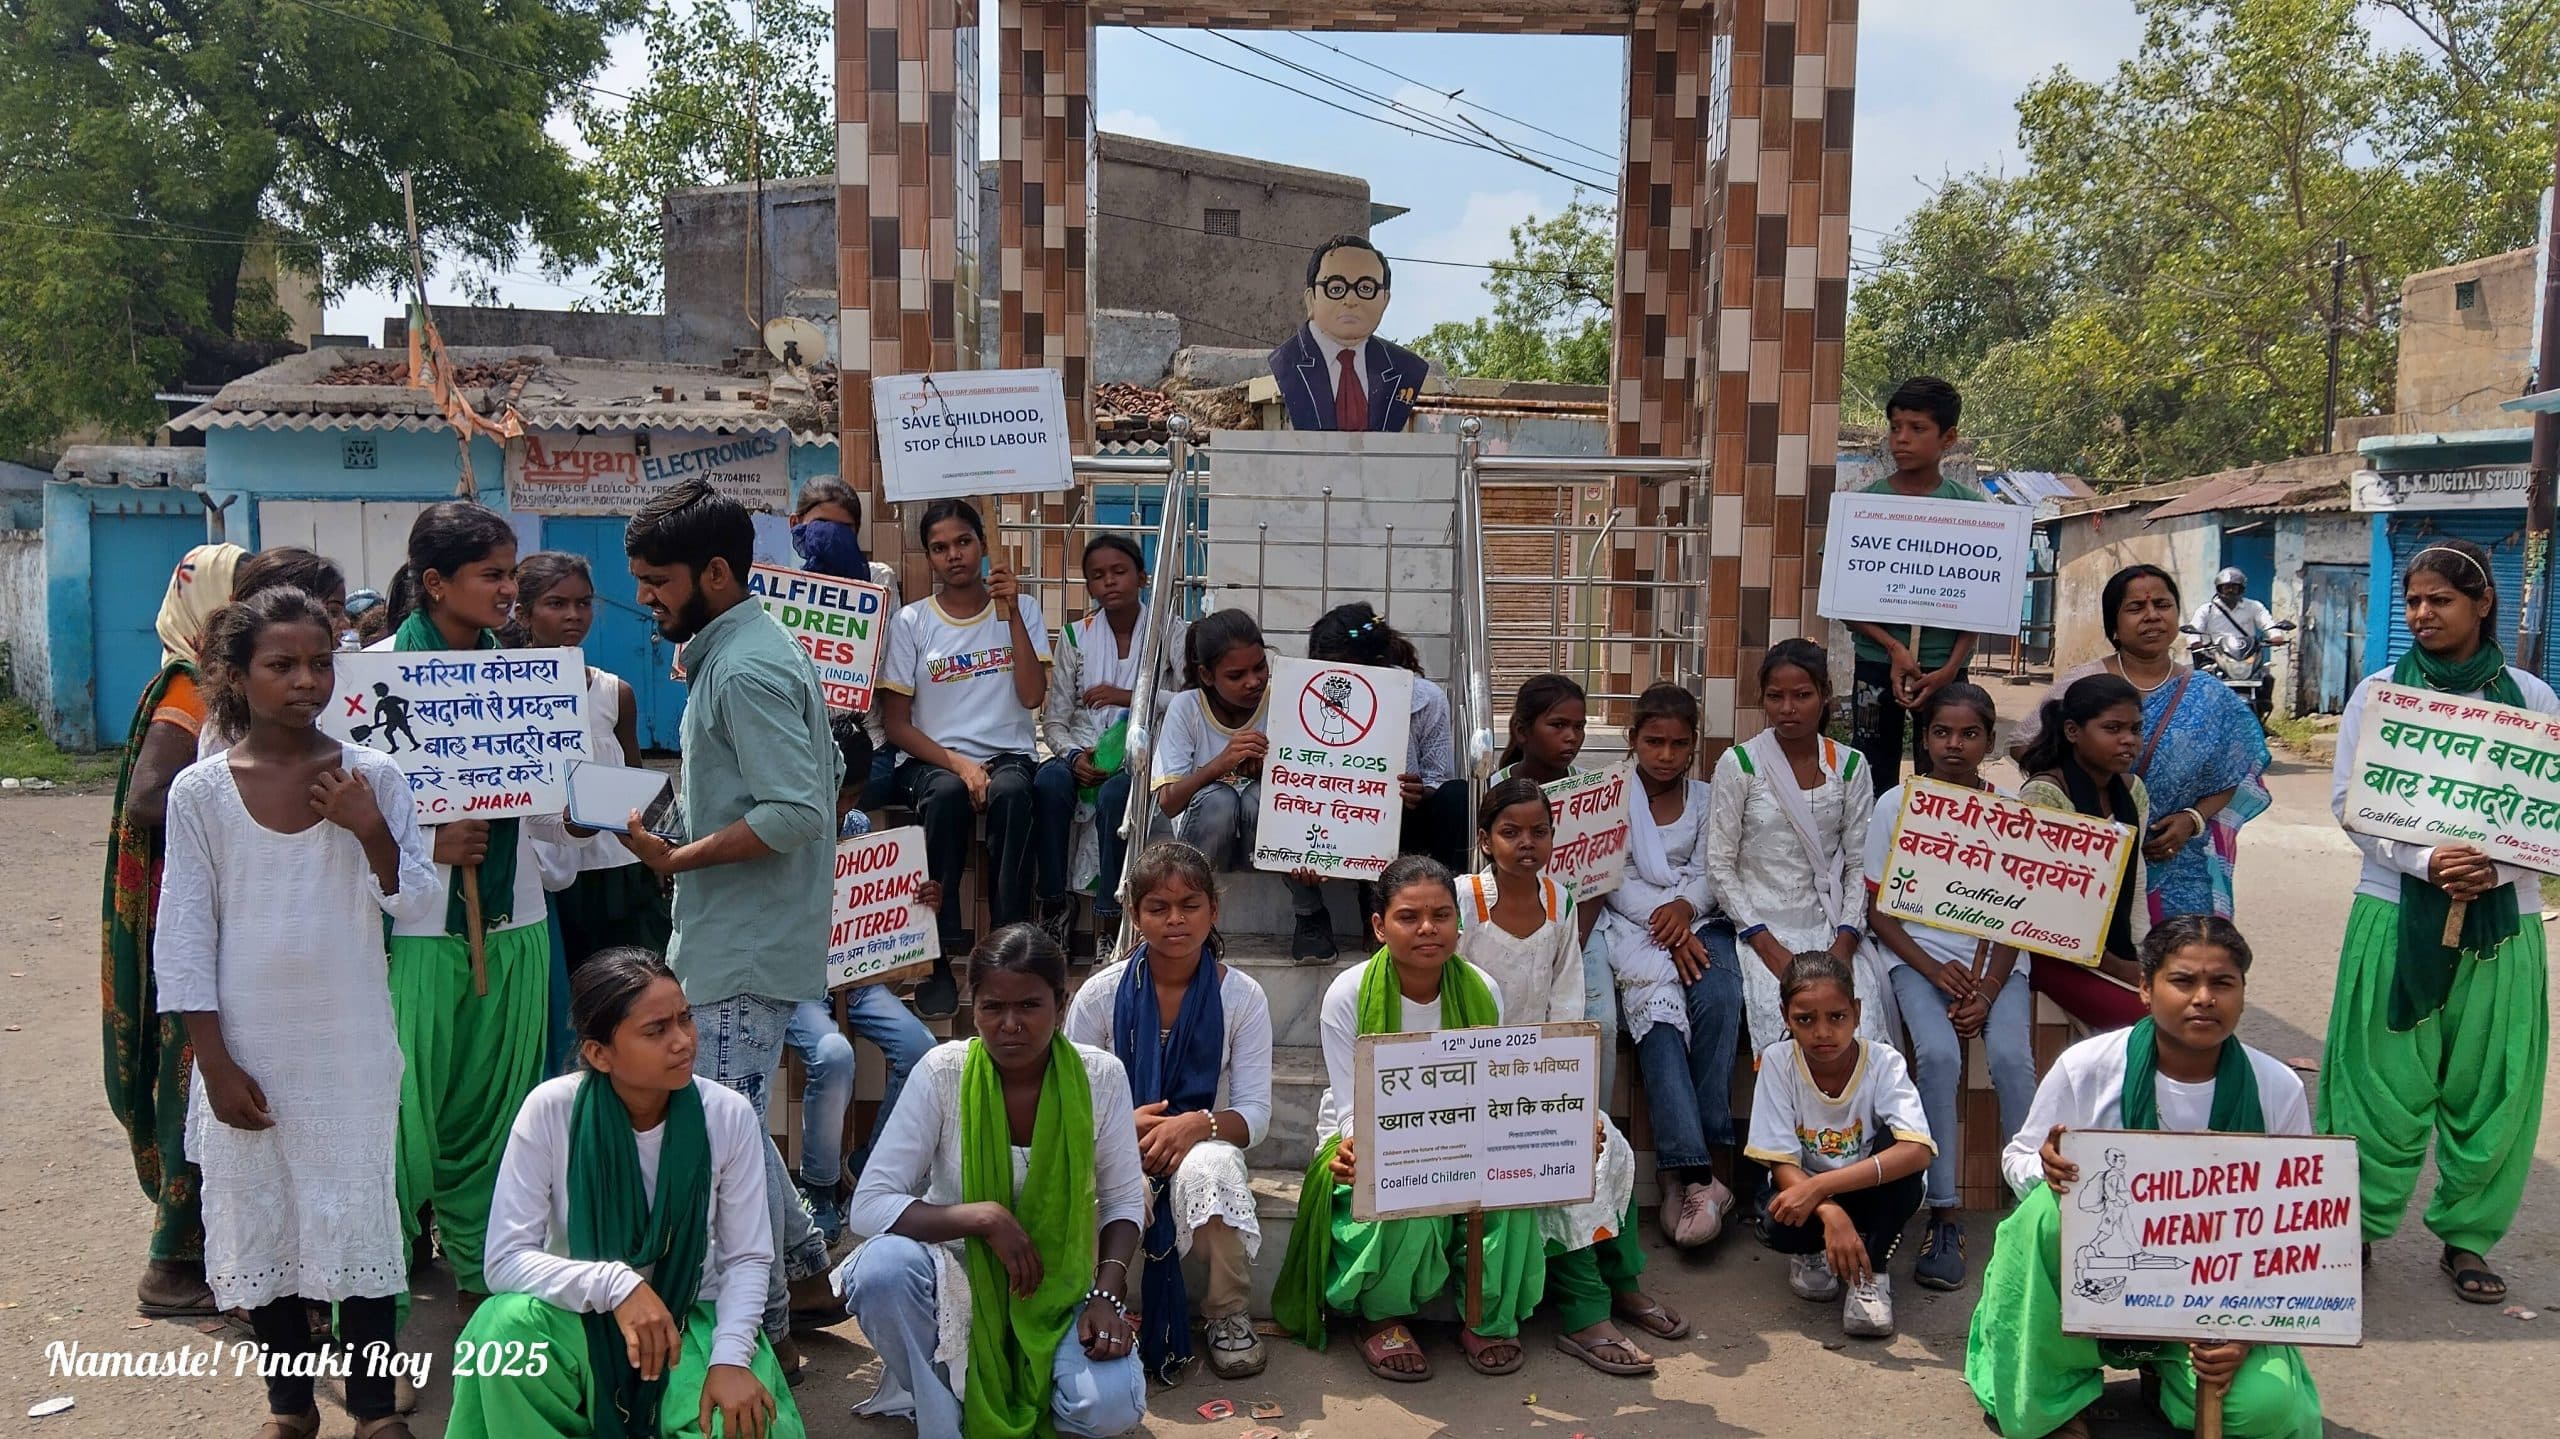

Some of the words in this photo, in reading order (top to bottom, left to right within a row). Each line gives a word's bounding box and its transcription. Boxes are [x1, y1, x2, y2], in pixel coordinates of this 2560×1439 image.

[902, 414, 941, 430] SAVE
[945, 409, 1044, 426] CHILDHOOD,
[905, 440, 940, 452] STOP
[945, 435, 985, 449] CHILD
[990, 432, 1047, 446] LABOUR
[520, 436, 639, 483] Aryan
[642, 436, 778, 481] ELECTRONICS
[515, 483, 534, 492] ALL
[539, 483, 571, 493] TYPES
[573, 484, 587, 492] OF
[591, 483, 631, 493] LED/LCD
[2429, 472, 2483, 491] DIGITAL
[2486, 470, 2532, 490] STUDI
[1851, 535, 1892, 550] SAVE
[1897, 538, 2002, 562] CHILDHOOD,
[1848, 559, 1885, 572] STOP
[1890, 561, 1934, 576] CHILD
[1939, 565, 2000, 583] LABOUR
[749, 573, 878, 614] ALFIELD
[1886, 583, 1906, 593] 12th
[1909, 585, 1936, 596] June
[1940, 587, 1966, 598] 2025
[764, 602, 868, 640] DREN
[797, 636, 854, 665] SES
[481, 655, 559, 684] कोयला
[825, 666, 869, 686] (INDIA)
[414, 692, 484, 727] खदानों
[486, 690, 504, 725] से
[2378, 690, 2391, 704] 12
[2429, 701, 2459, 720] बाल
[2461, 707, 2488, 721] श्रम
[2493, 710, 2541, 731] निषेध
[2545, 717, 2560, 741] दि
[547, 730, 586, 754] बन्द
[2380, 718, 2485, 765] बचपन
[1279, 747, 1292, 760] 12
[1342, 754, 1387, 772] 2025
[1318, 775, 1354, 794] बाल
[1357, 780, 1387, 797] श्रम
[1569, 774, 1624, 820] बचाओ
[2364, 762, 2424, 807] बाल
[2428, 775, 2525, 830] मजदूरी
[463, 792, 532, 812] JHARIA
[1274, 793, 1326, 817] निषेध
[1910, 791, 1984, 830] आधी
[1984, 802, 2037, 842] रोटी
[2359, 807, 2422, 829] Coalfield
[2426, 820, 2487, 842] Children
[2495, 834, 2560, 857] Classes
[835, 842, 899, 879] DHOOD
[1546, 832, 1590, 877] जदूरी
[1958, 840, 1996, 873] को
[849, 870, 921, 909] DREAMS
[1946, 880, 2026, 910] Coalfield
[1935, 901, 2004, 930] Children
[2010, 920, 2081, 950] Classes
[1442, 1037, 1465, 1051] 12th
[1469, 1036, 1501, 1049] June
[1506, 1033, 1537, 1046] 2025
[1379, 1067, 1413, 1096] हर
[1419, 1061, 1477, 1089] बच्चा
[1488, 1060, 1510, 1078] देश
[1513, 1059, 1529, 1075] कि
[1378, 1111, 1425, 1131] ख्याल
[1429, 1106, 1476, 1126] रखना
[1488, 1099, 1512, 1120] देश
[1516, 1098, 1537, 1116] कि
[1541, 1093, 1584, 1114] कर्तव्य
[1381, 1174, 1428, 1190] Coalfield
[1431, 1169, 1477, 1184] Children
[1487, 1167, 1536, 1181] Classes,
[1540, 1162, 1575, 1178] Jharia
[2131, 1161, 2260, 1202] CHILDREN
[2276, 1155, 2323, 1190] ARE
[2142, 1211, 2227, 1247] MEANT
[2234, 1207, 2263, 1238] TO
[2274, 1197, 2351, 1234] LEARN
[2191, 1252, 2242, 1285] NOT
[2125, 1294, 2175, 1308] WORLD
[2183, 1295, 2214, 1309] DAY
[2220, 1296, 2284, 1310] AGAINST
[2262, 1315, 2321, 1328] JHARIA
